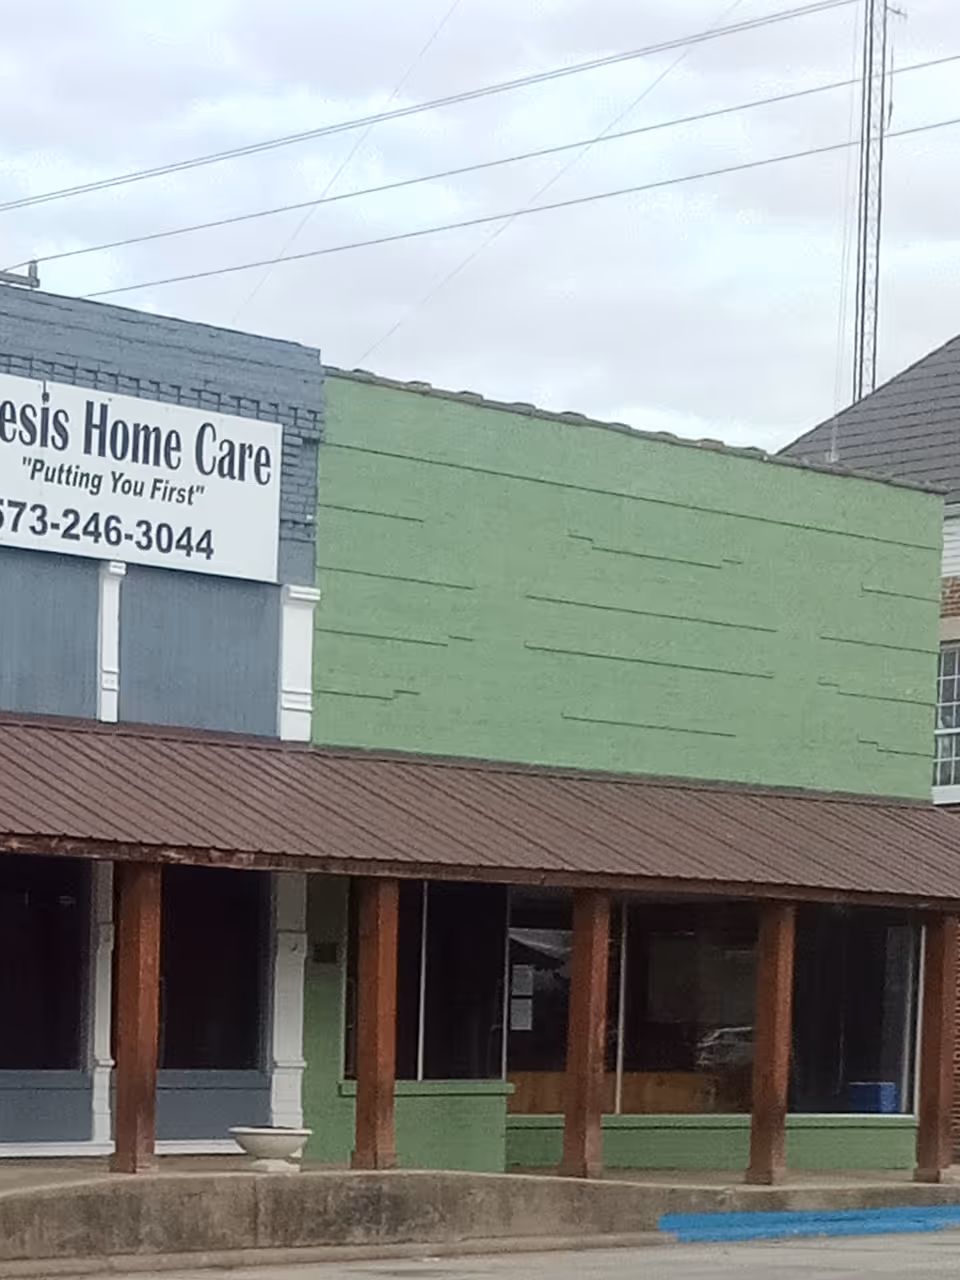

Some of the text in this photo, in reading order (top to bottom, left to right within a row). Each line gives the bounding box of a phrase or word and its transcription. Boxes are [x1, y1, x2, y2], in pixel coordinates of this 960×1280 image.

[83, 400, 182, 470] Home
[195, 422, 272, 485] Care
[22, 456, 205, 506] "Putting You First"
